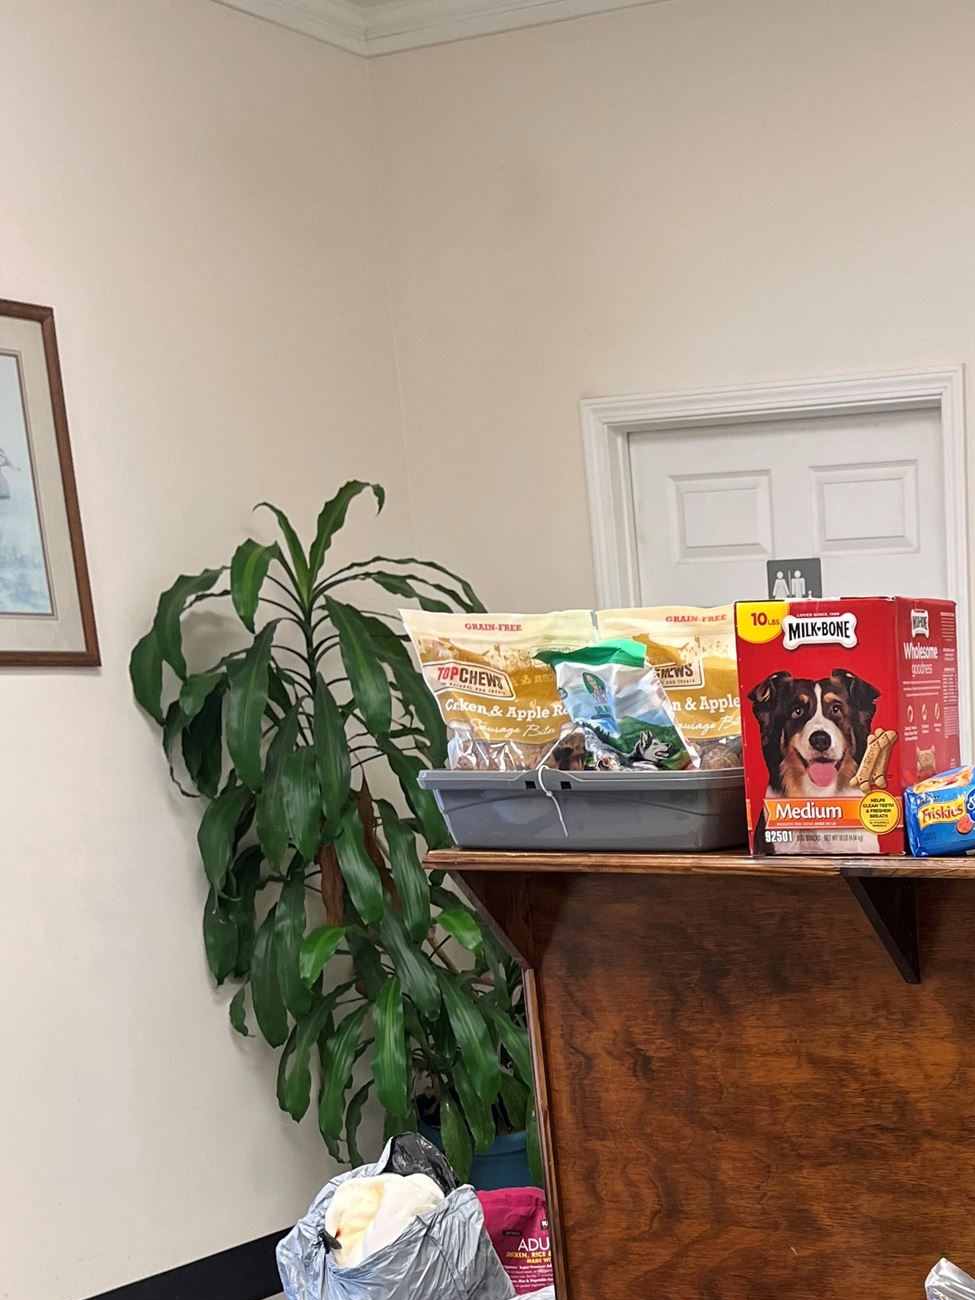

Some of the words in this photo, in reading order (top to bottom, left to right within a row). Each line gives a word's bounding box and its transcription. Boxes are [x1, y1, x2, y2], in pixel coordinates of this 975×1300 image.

[665, 614, 727, 623] GRAIN-FREE
[751, 612, 767, 626] 10
[464, 623, 523, 632] GRAIN-FREE
[902, 641, 939, 660] Wholesome
[911, 663, 934, 678] goodness
[684, 697, 697, 712] &
[699, 694, 741, 713] Apple
[490, 705, 503, 717] &
[507, 706, 550, 723] Apple
[775, 801, 842, 820] Medium
[921, 803, 964, 824] Friskies
[765, 830, 793, 843] 92501
